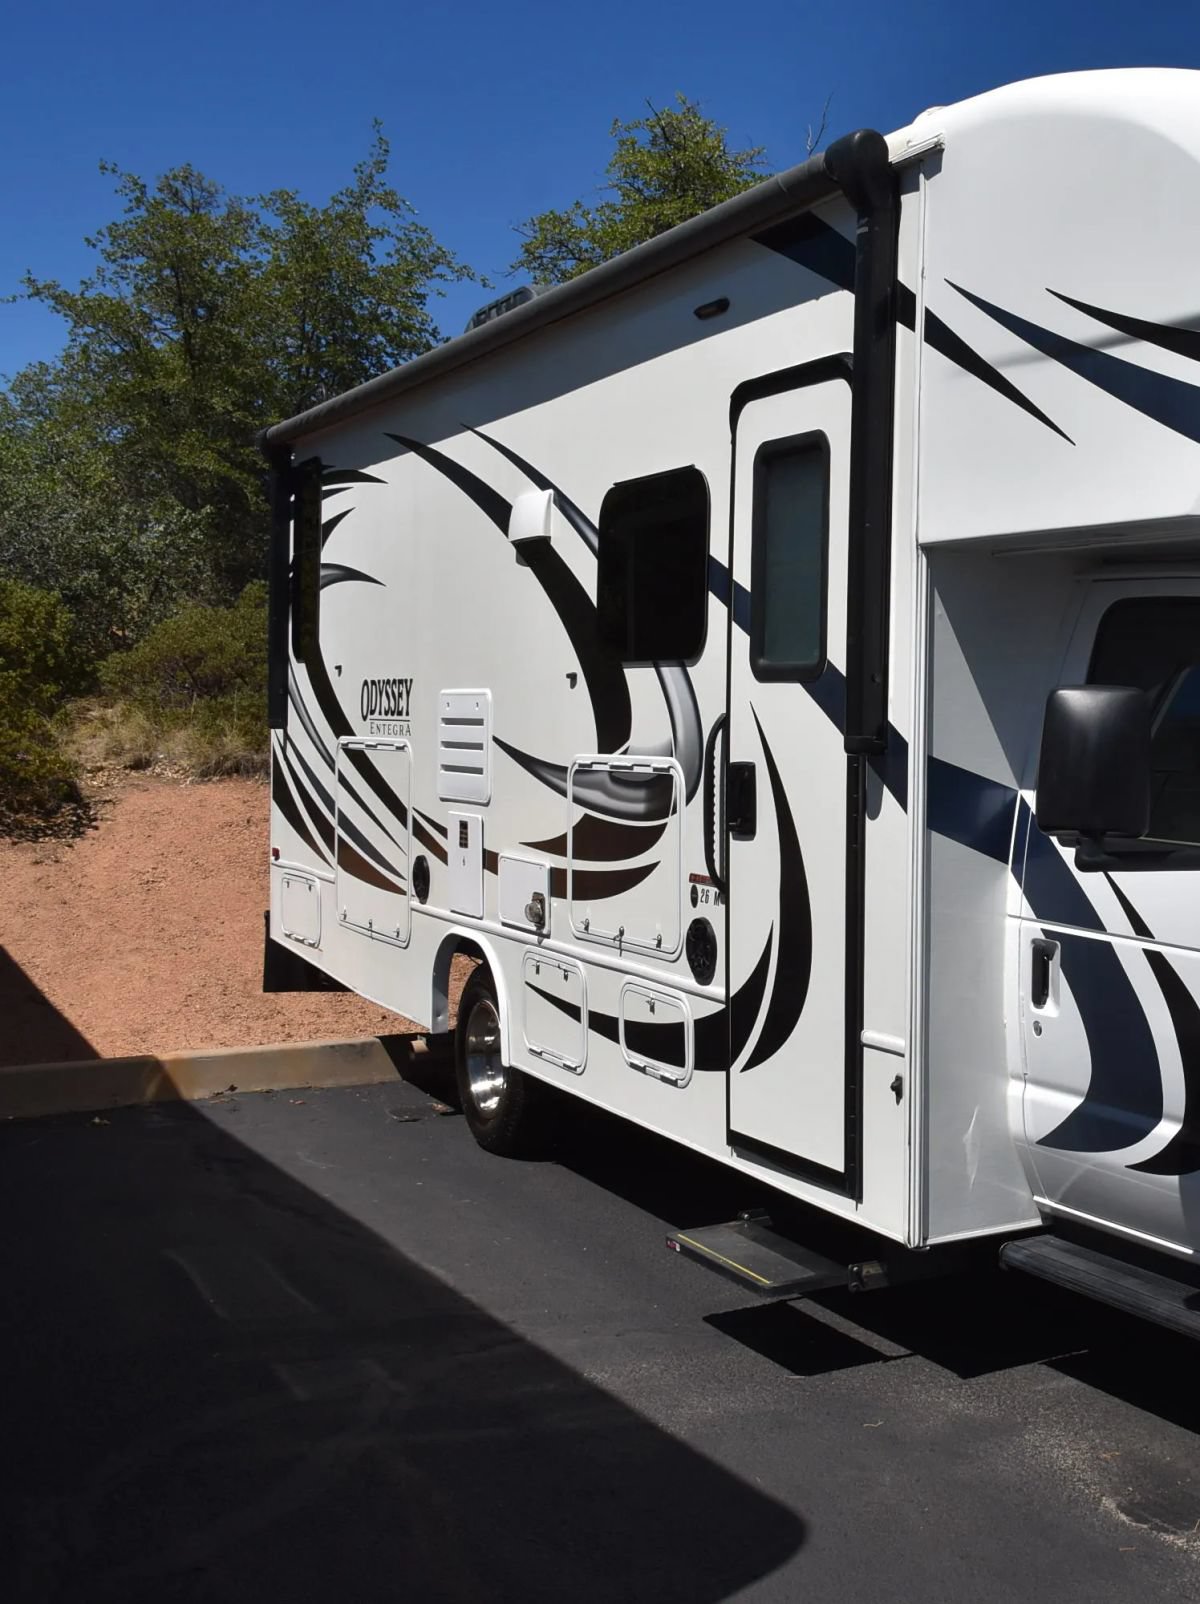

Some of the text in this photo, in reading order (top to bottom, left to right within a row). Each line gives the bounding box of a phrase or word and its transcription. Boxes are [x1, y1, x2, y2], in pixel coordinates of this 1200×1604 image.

[360, 678, 413, 722] ODYSSEY
[369, 721, 412, 737] ENTEGRA
[700, 888, 710, 904] 26
